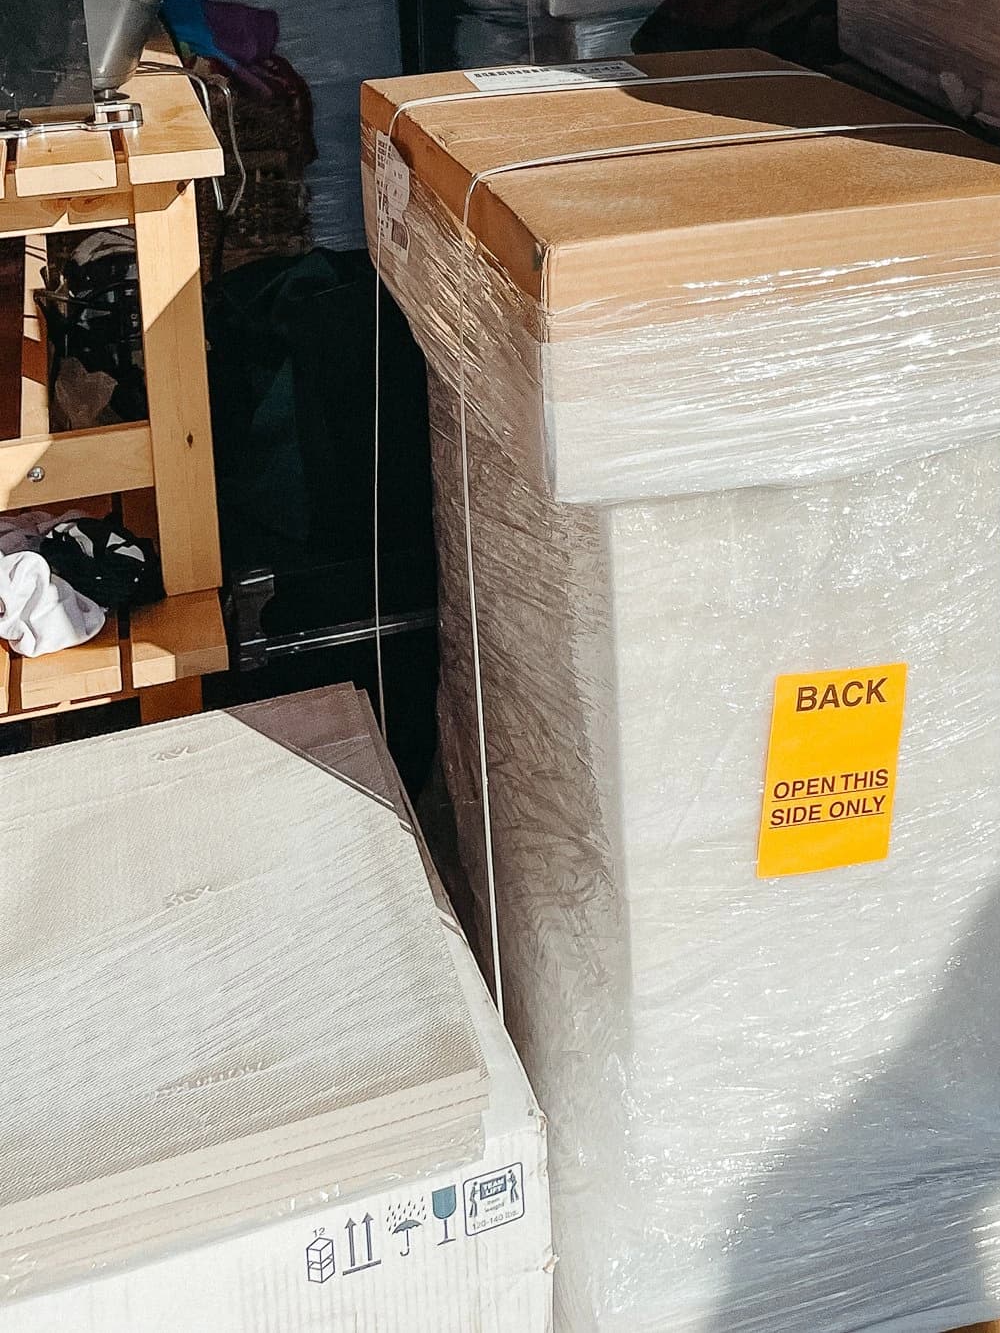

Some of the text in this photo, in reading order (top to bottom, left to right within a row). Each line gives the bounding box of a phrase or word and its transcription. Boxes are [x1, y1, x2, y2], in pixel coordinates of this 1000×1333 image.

[795, 677, 889, 712] BACK
[773, 768, 889, 800] OPEN THIS
[770, 794, 887, 827] SIDE ONLY
[312, 1226, 326, 1238] 12
